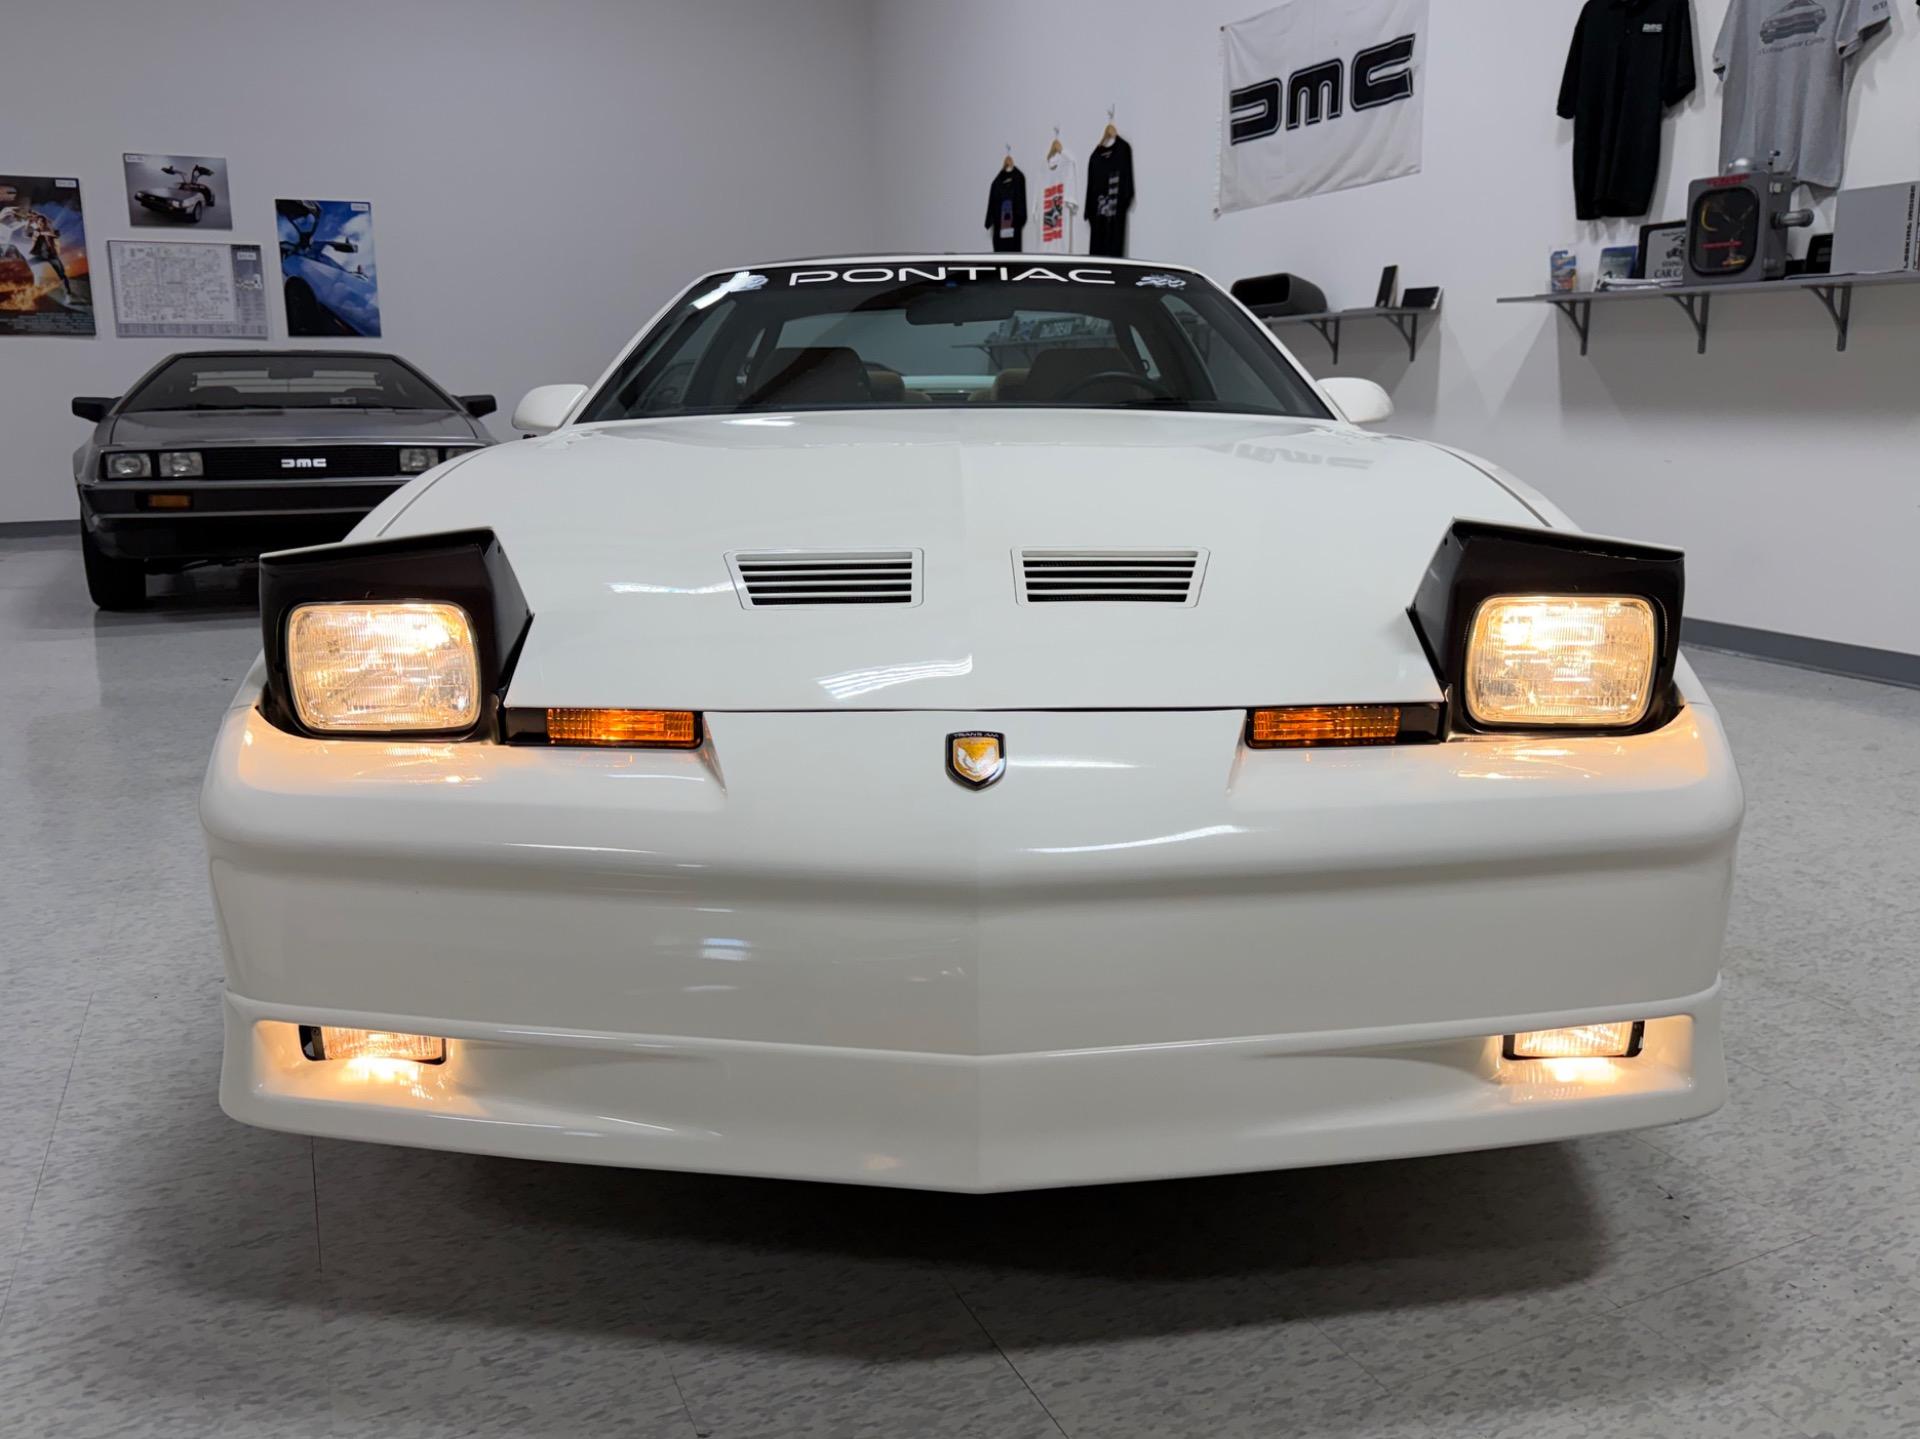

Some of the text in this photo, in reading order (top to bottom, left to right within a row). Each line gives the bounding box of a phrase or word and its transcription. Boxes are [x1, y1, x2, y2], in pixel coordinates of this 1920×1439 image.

[1231, 33, 1416, 146] DMC
[789, 267, 1116, 286] PONTIAC
[281, 458, 327, 468] DMC
